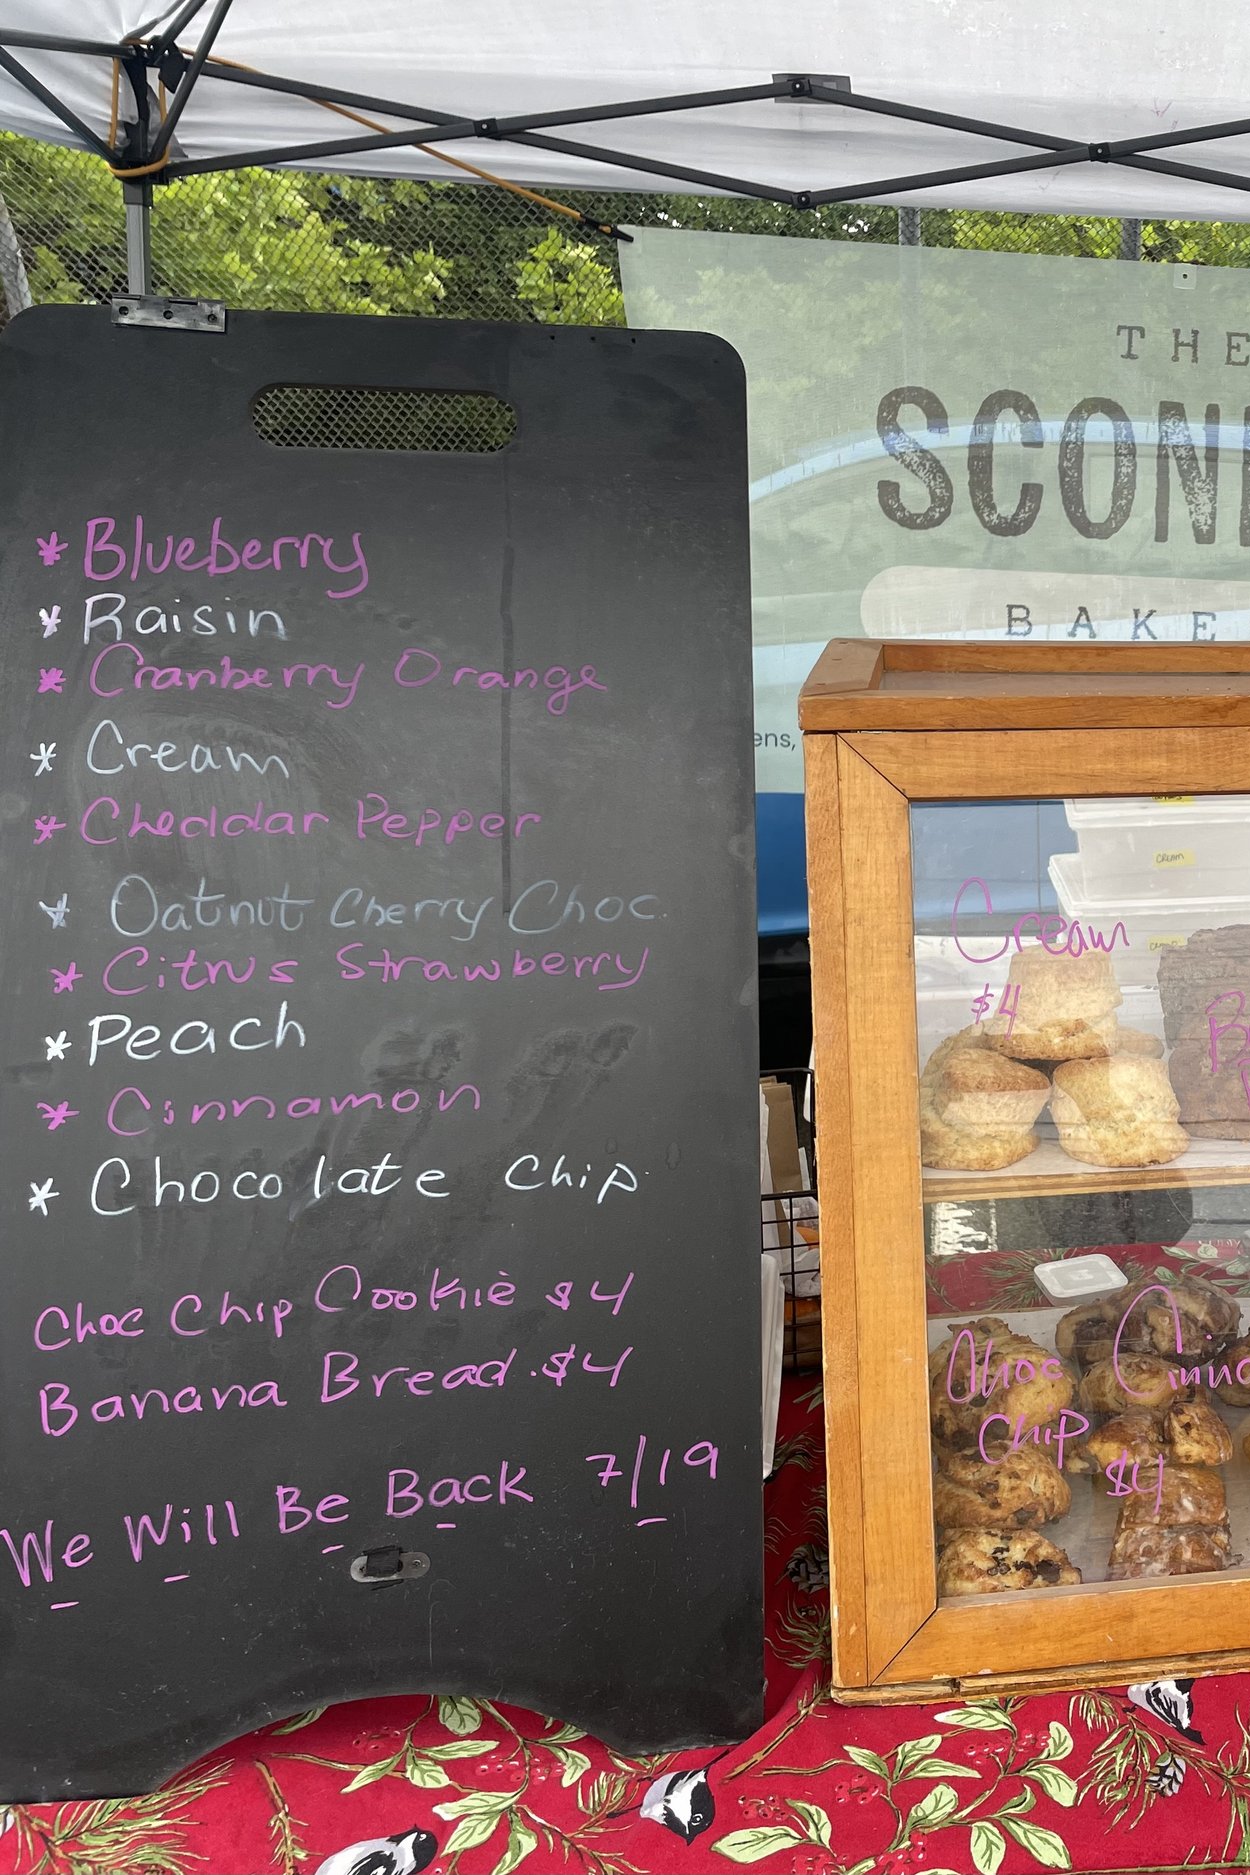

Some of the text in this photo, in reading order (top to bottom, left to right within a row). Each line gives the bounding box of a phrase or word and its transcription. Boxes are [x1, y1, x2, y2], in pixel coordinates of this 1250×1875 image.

[83, 514, 370, 599] Blueberry
[83, 592, 290, 643] Raisin
[89, 643, 607, 715] Cranberry Orange
[86, 720, 290, 778] Cream
[80, 793, 542, 846] Cheddar Pepper
[110, 874, 313, 937] Oatnut
[329, 888, 495, 940] Cherry
[952, 876, 1130, 964] Cream
[104, 942, 650, 996] Citrus Strawberry
[88, 1000, 306, 1066] Peach
[972, 983, 1021, 1039] $4
[107, 1082, 481, 1136] Cinnamon
[91, 1155, 450, 1215] Chocolate
[34, 1304, 144, 1351] Choc
[169, 1293, 293, 1338] Chip
[315, 1264, 516, 1314] Cookie
[946, 1329, 1064, 1404] Choc
[39, 1380, 288, 1436] Banana
[978, 1408, 1090, 1469] Chip
[0, 1435, 718, 1587] We Will Be Back 7/19
[1105, 1450, 1167, 1514] $4
